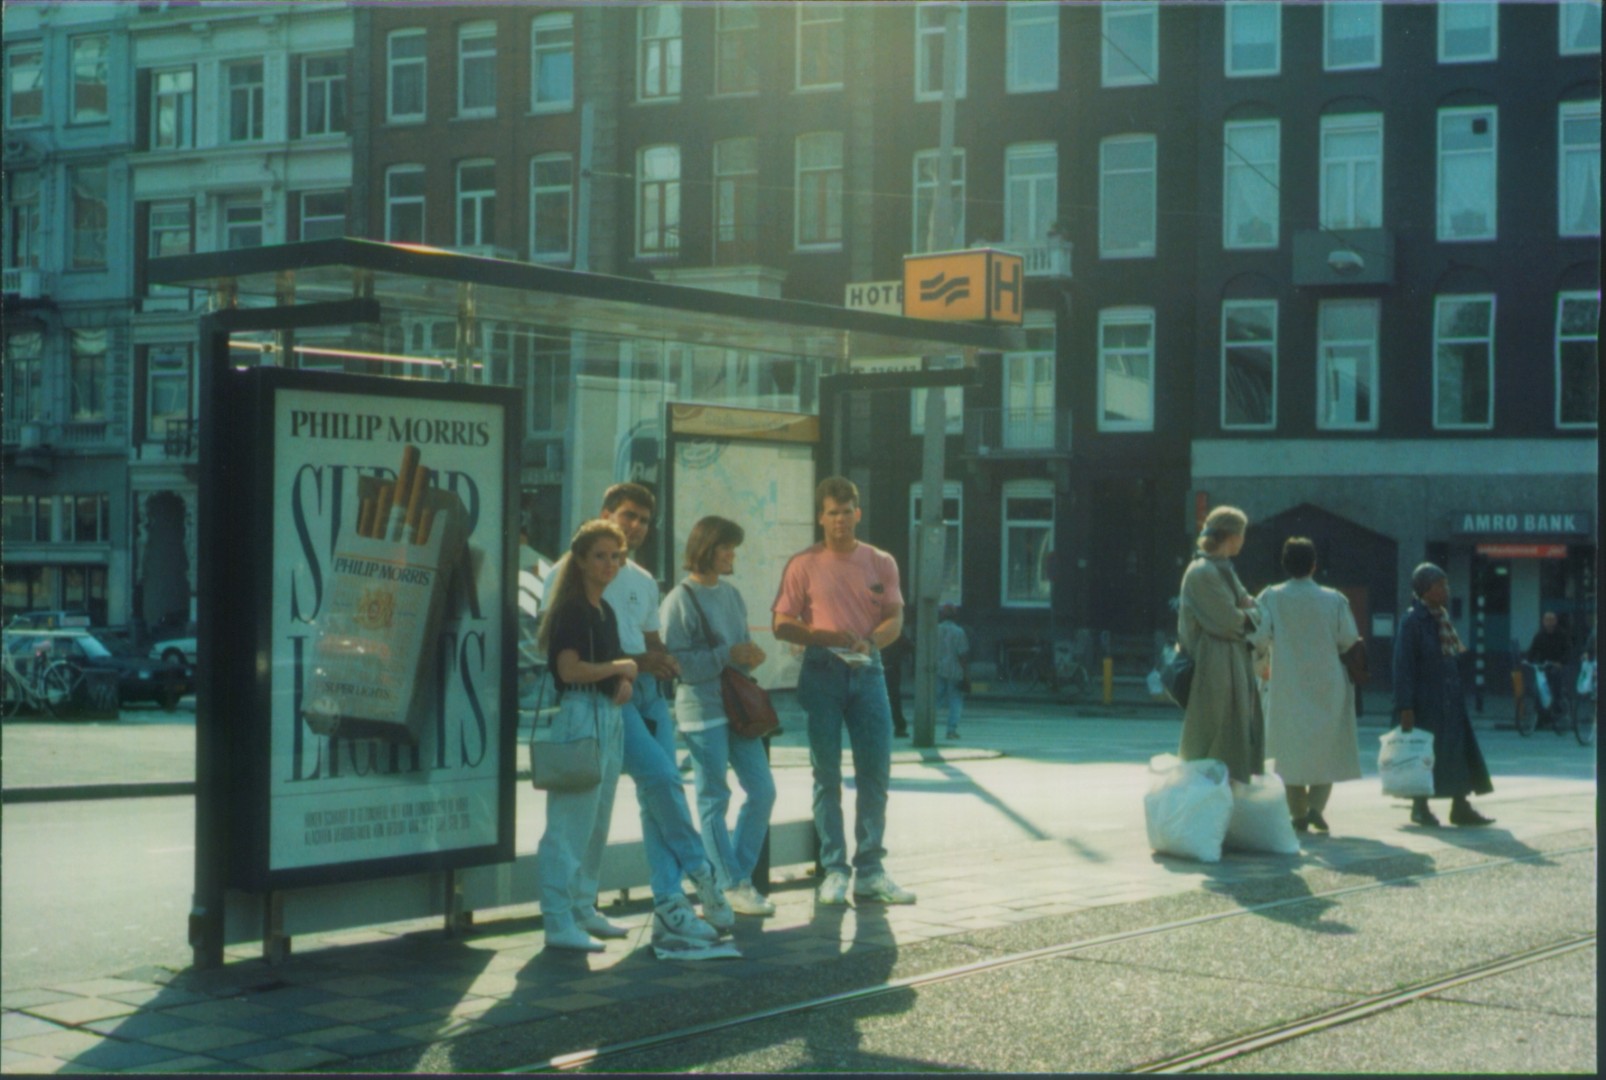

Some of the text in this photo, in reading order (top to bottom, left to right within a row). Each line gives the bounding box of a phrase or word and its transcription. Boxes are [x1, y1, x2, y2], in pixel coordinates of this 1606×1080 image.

[994, 261, 1020, 314] H
[290, 410, 490, 447] PHILIP MORRIS
[1463, 513, 1576, 532] AMRO BANK
[334, 557, 431, 587] PHILIP MORRIS
